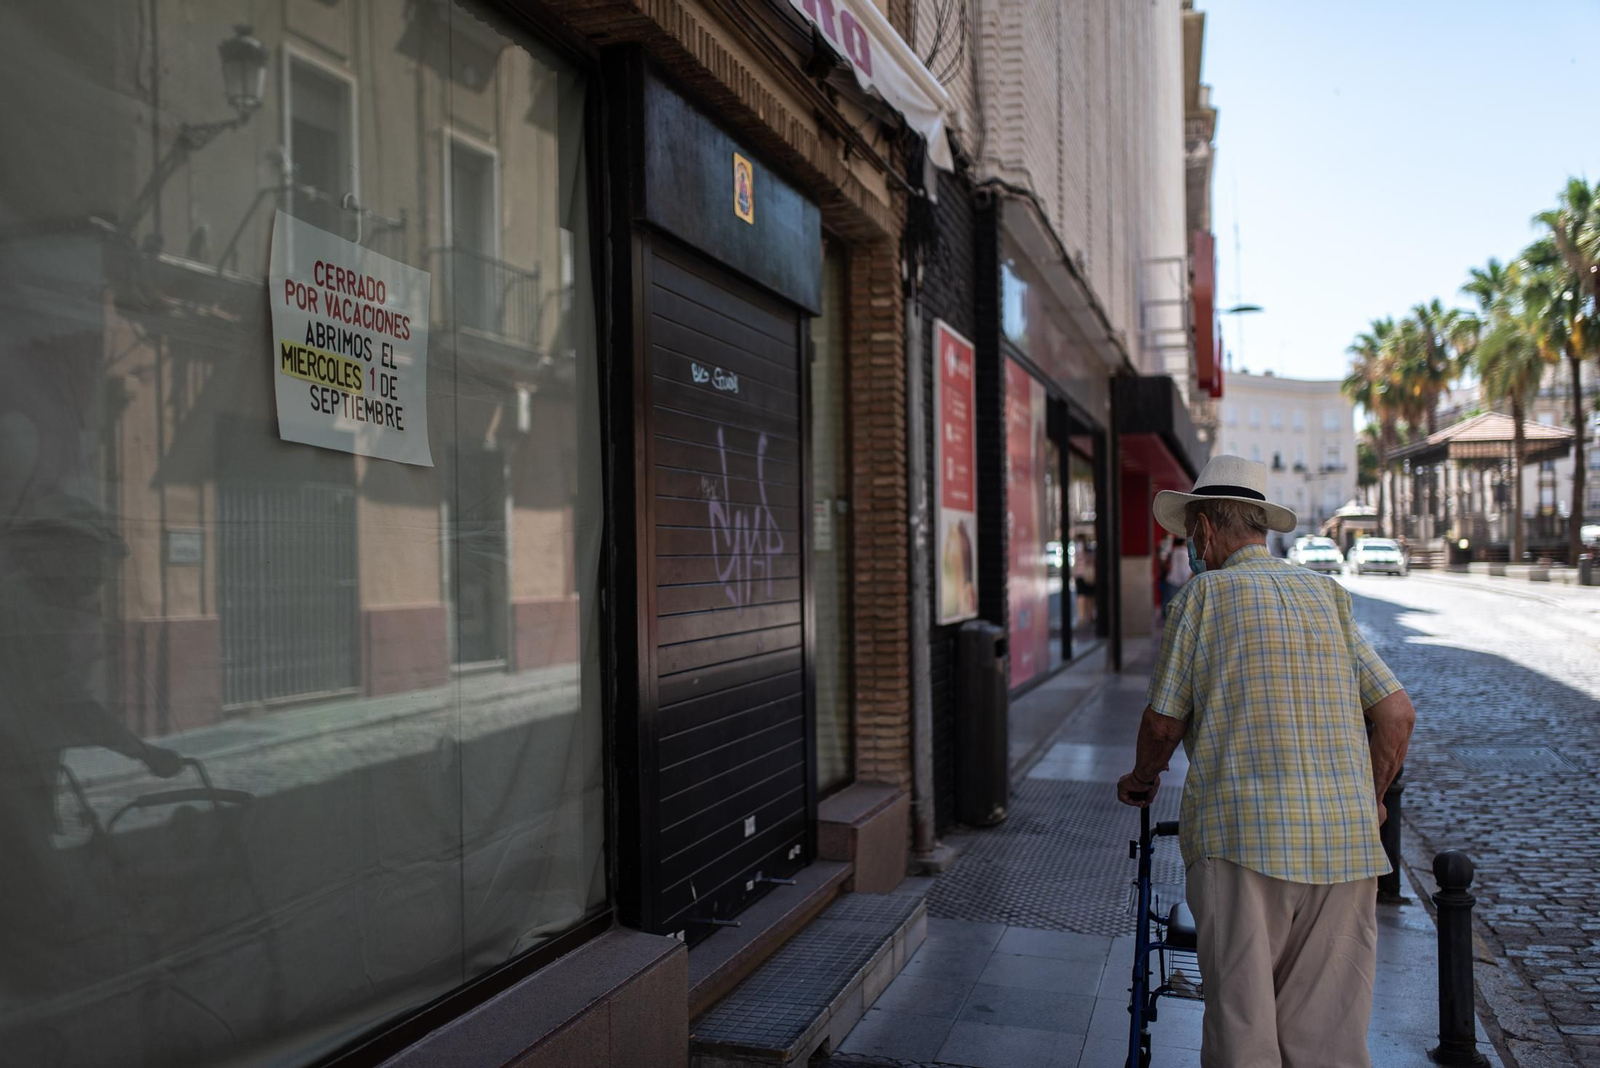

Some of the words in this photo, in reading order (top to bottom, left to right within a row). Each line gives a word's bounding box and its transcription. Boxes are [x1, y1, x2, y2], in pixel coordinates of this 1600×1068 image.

[314, 260, 386, 305] CERRADO
[285, 278, 318, 314] POR
[324, 291, 410, 341] VACACIONES
[305, 320, 373, 362] ABRIMOS
[381, 343, 398, 370] EL
[281, 342, 362, 391] MIERCOLES
[369, 367, 376, 391] 1
[381, 373, 398, 401] DE
[309, 385, 404, 431] SEPTIEMBRE
